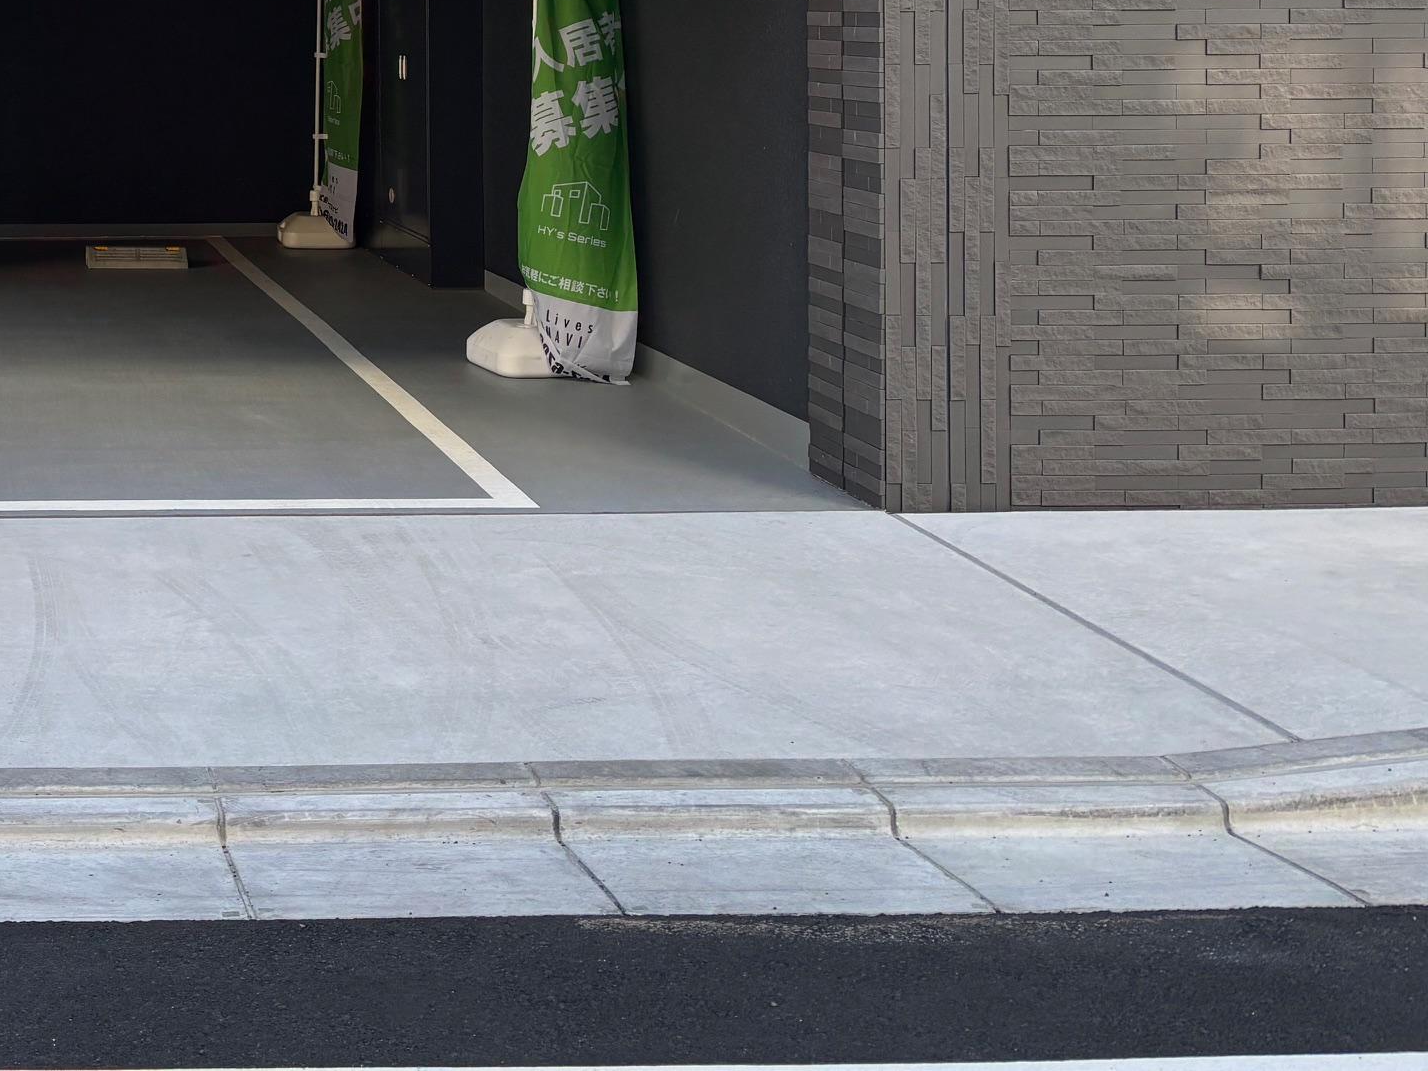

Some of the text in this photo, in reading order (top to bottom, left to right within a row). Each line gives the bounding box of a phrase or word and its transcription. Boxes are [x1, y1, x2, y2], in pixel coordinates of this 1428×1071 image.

[530, 70, 625, 157] 募集
[537, 224, 607, 248] HY's Series
